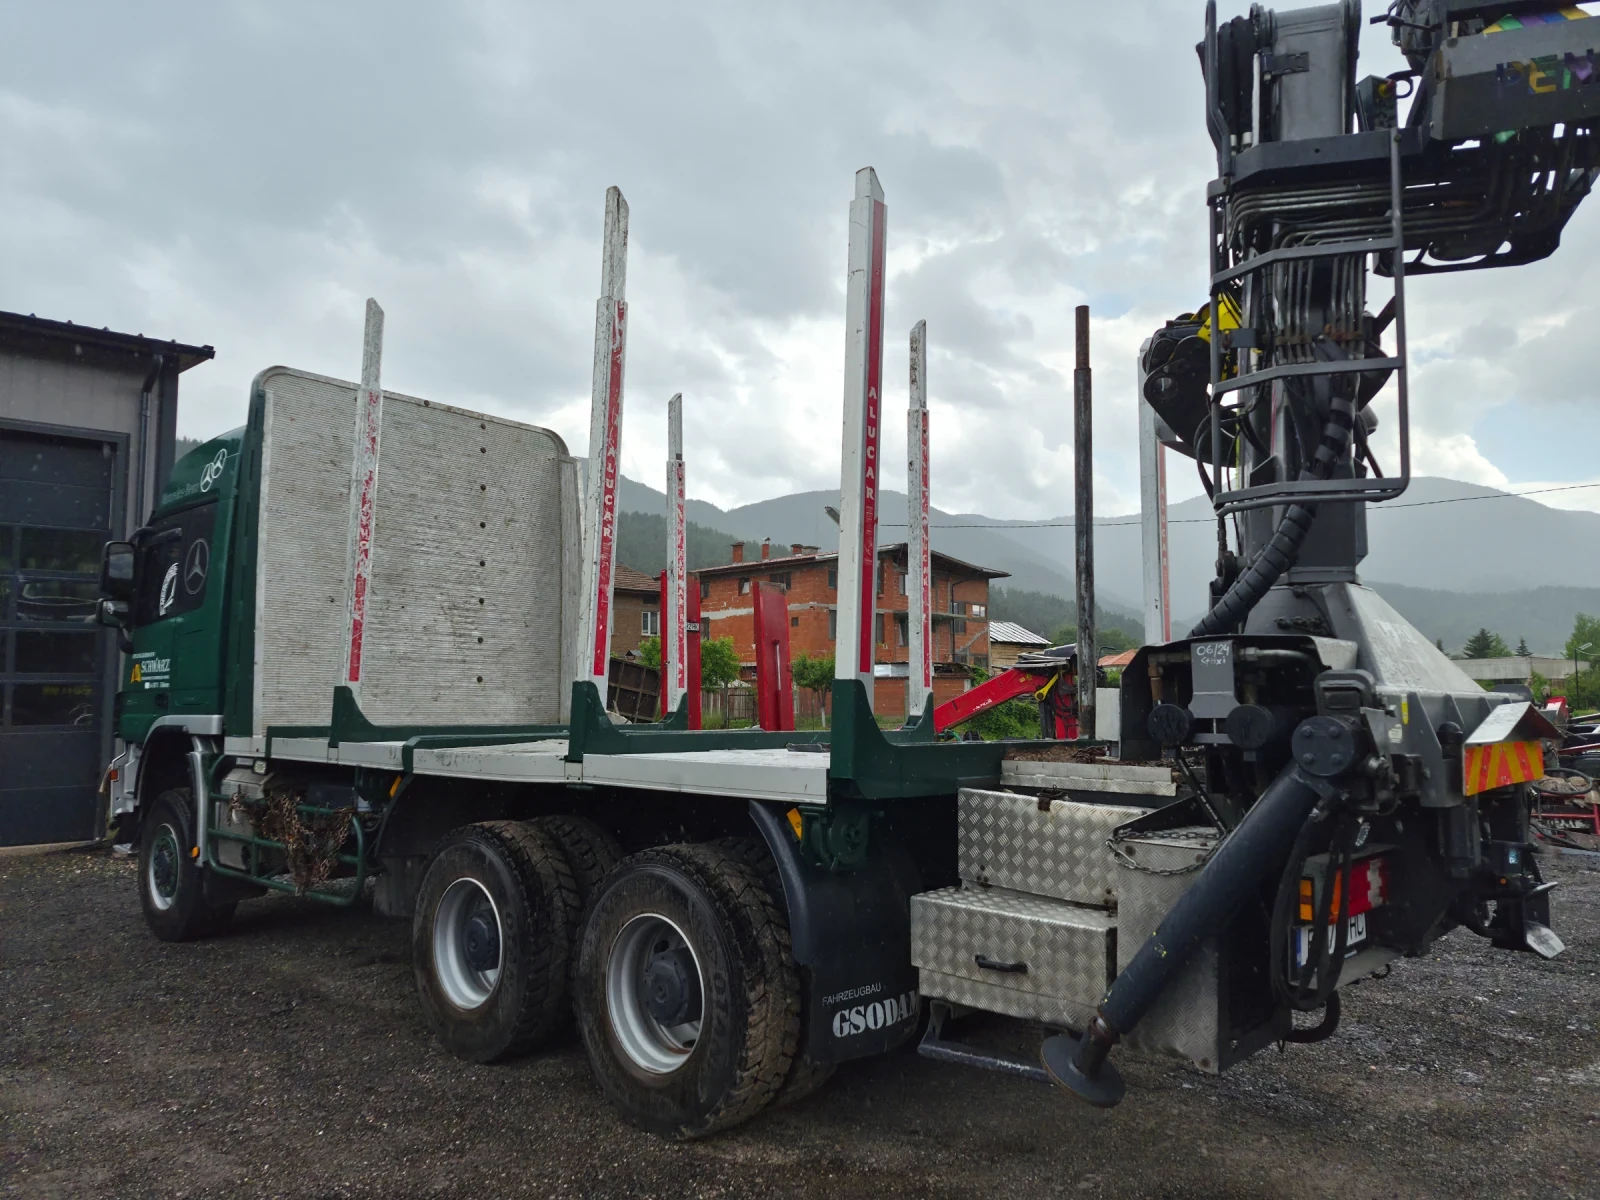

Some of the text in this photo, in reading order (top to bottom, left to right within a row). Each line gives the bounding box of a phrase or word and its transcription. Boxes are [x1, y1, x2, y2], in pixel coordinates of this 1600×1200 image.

[865, 386, 878, 501] ALUCAR
[602, 446, 618, 538] ALUCAR
[1160, 486, 1168, 567] ALUCAR
[141, 658, 171, 673] SCHWARZ
[1196, 643, 1230, 658] 06/24
[822, 982, 882, 1007] FAHRZEUGBAU
